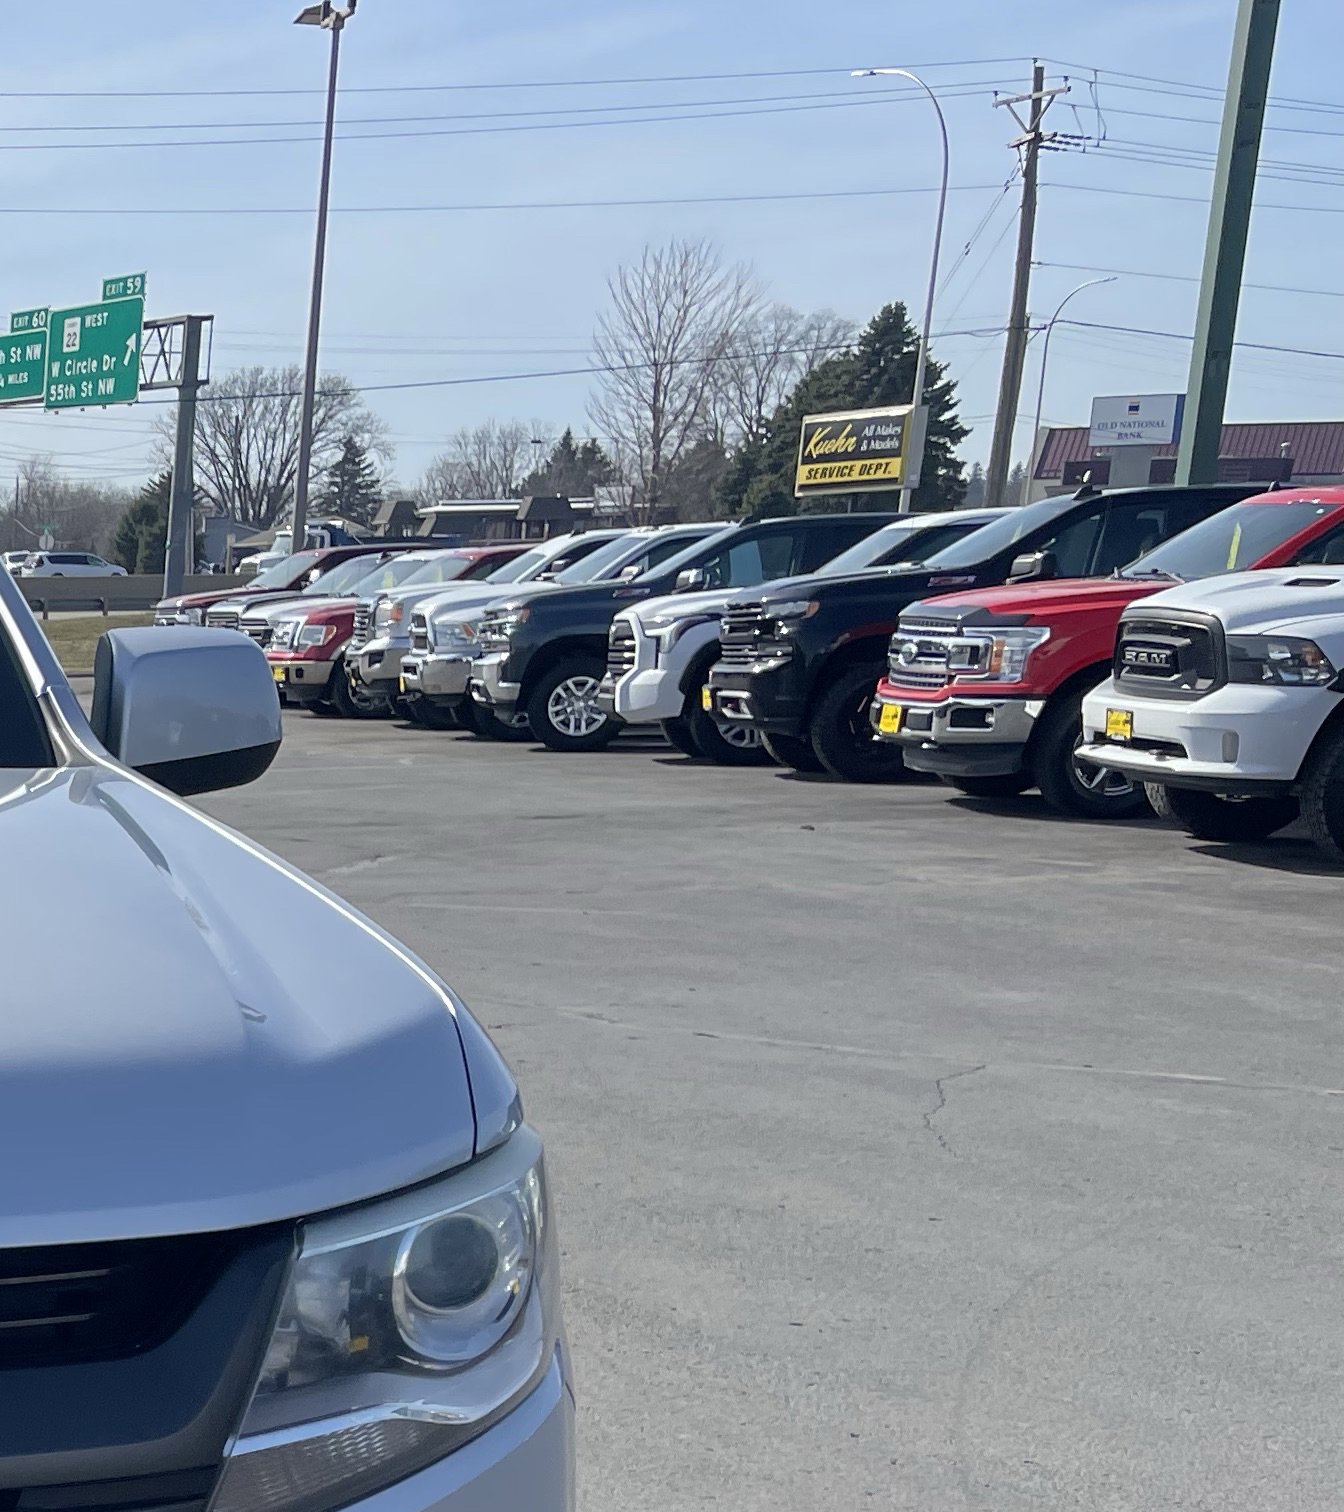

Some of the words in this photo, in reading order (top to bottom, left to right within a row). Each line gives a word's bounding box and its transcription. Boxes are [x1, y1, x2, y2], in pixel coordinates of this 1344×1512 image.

[105, 282, 124, 296] EXIT
[126, 277, 142, 295] 59
[14, 316, 29, 329] EXIT
[31, 311, 46, 328] 60
[84, 312, 109, 328] WEST
[66, 332, 78, 348] 22
[10, 348, 22, 364] St
[26, 344, 42, 361] NW
[51, 362, 61, 378] W
[64, 357, 98, 376] Circle
[102, 354, 117, 371] Dr
[8, 372, 29, 385] MILES
[50, 384, 76, 402] 55th
[80, 381, 93, 398] St
[97, 378, 116, 396] NW
[861, 424, 876, 437] All
[875, 423, 902, 436] Makes
[1097, 421, 1118, 430] OLD
[1119, 419, 1166, 430] NATIONAL
[804, 423, 857, 459] Kuehn
[1117, 431, 1143, 440] BANK
[860, 440, 868, 452] &
[869, 437, 900, 450] Models
[806, 463, 856, 480] SERVICE
[858, 461, 892, 476] DEPT.
[1124, 651, 1167, 664] RAM
